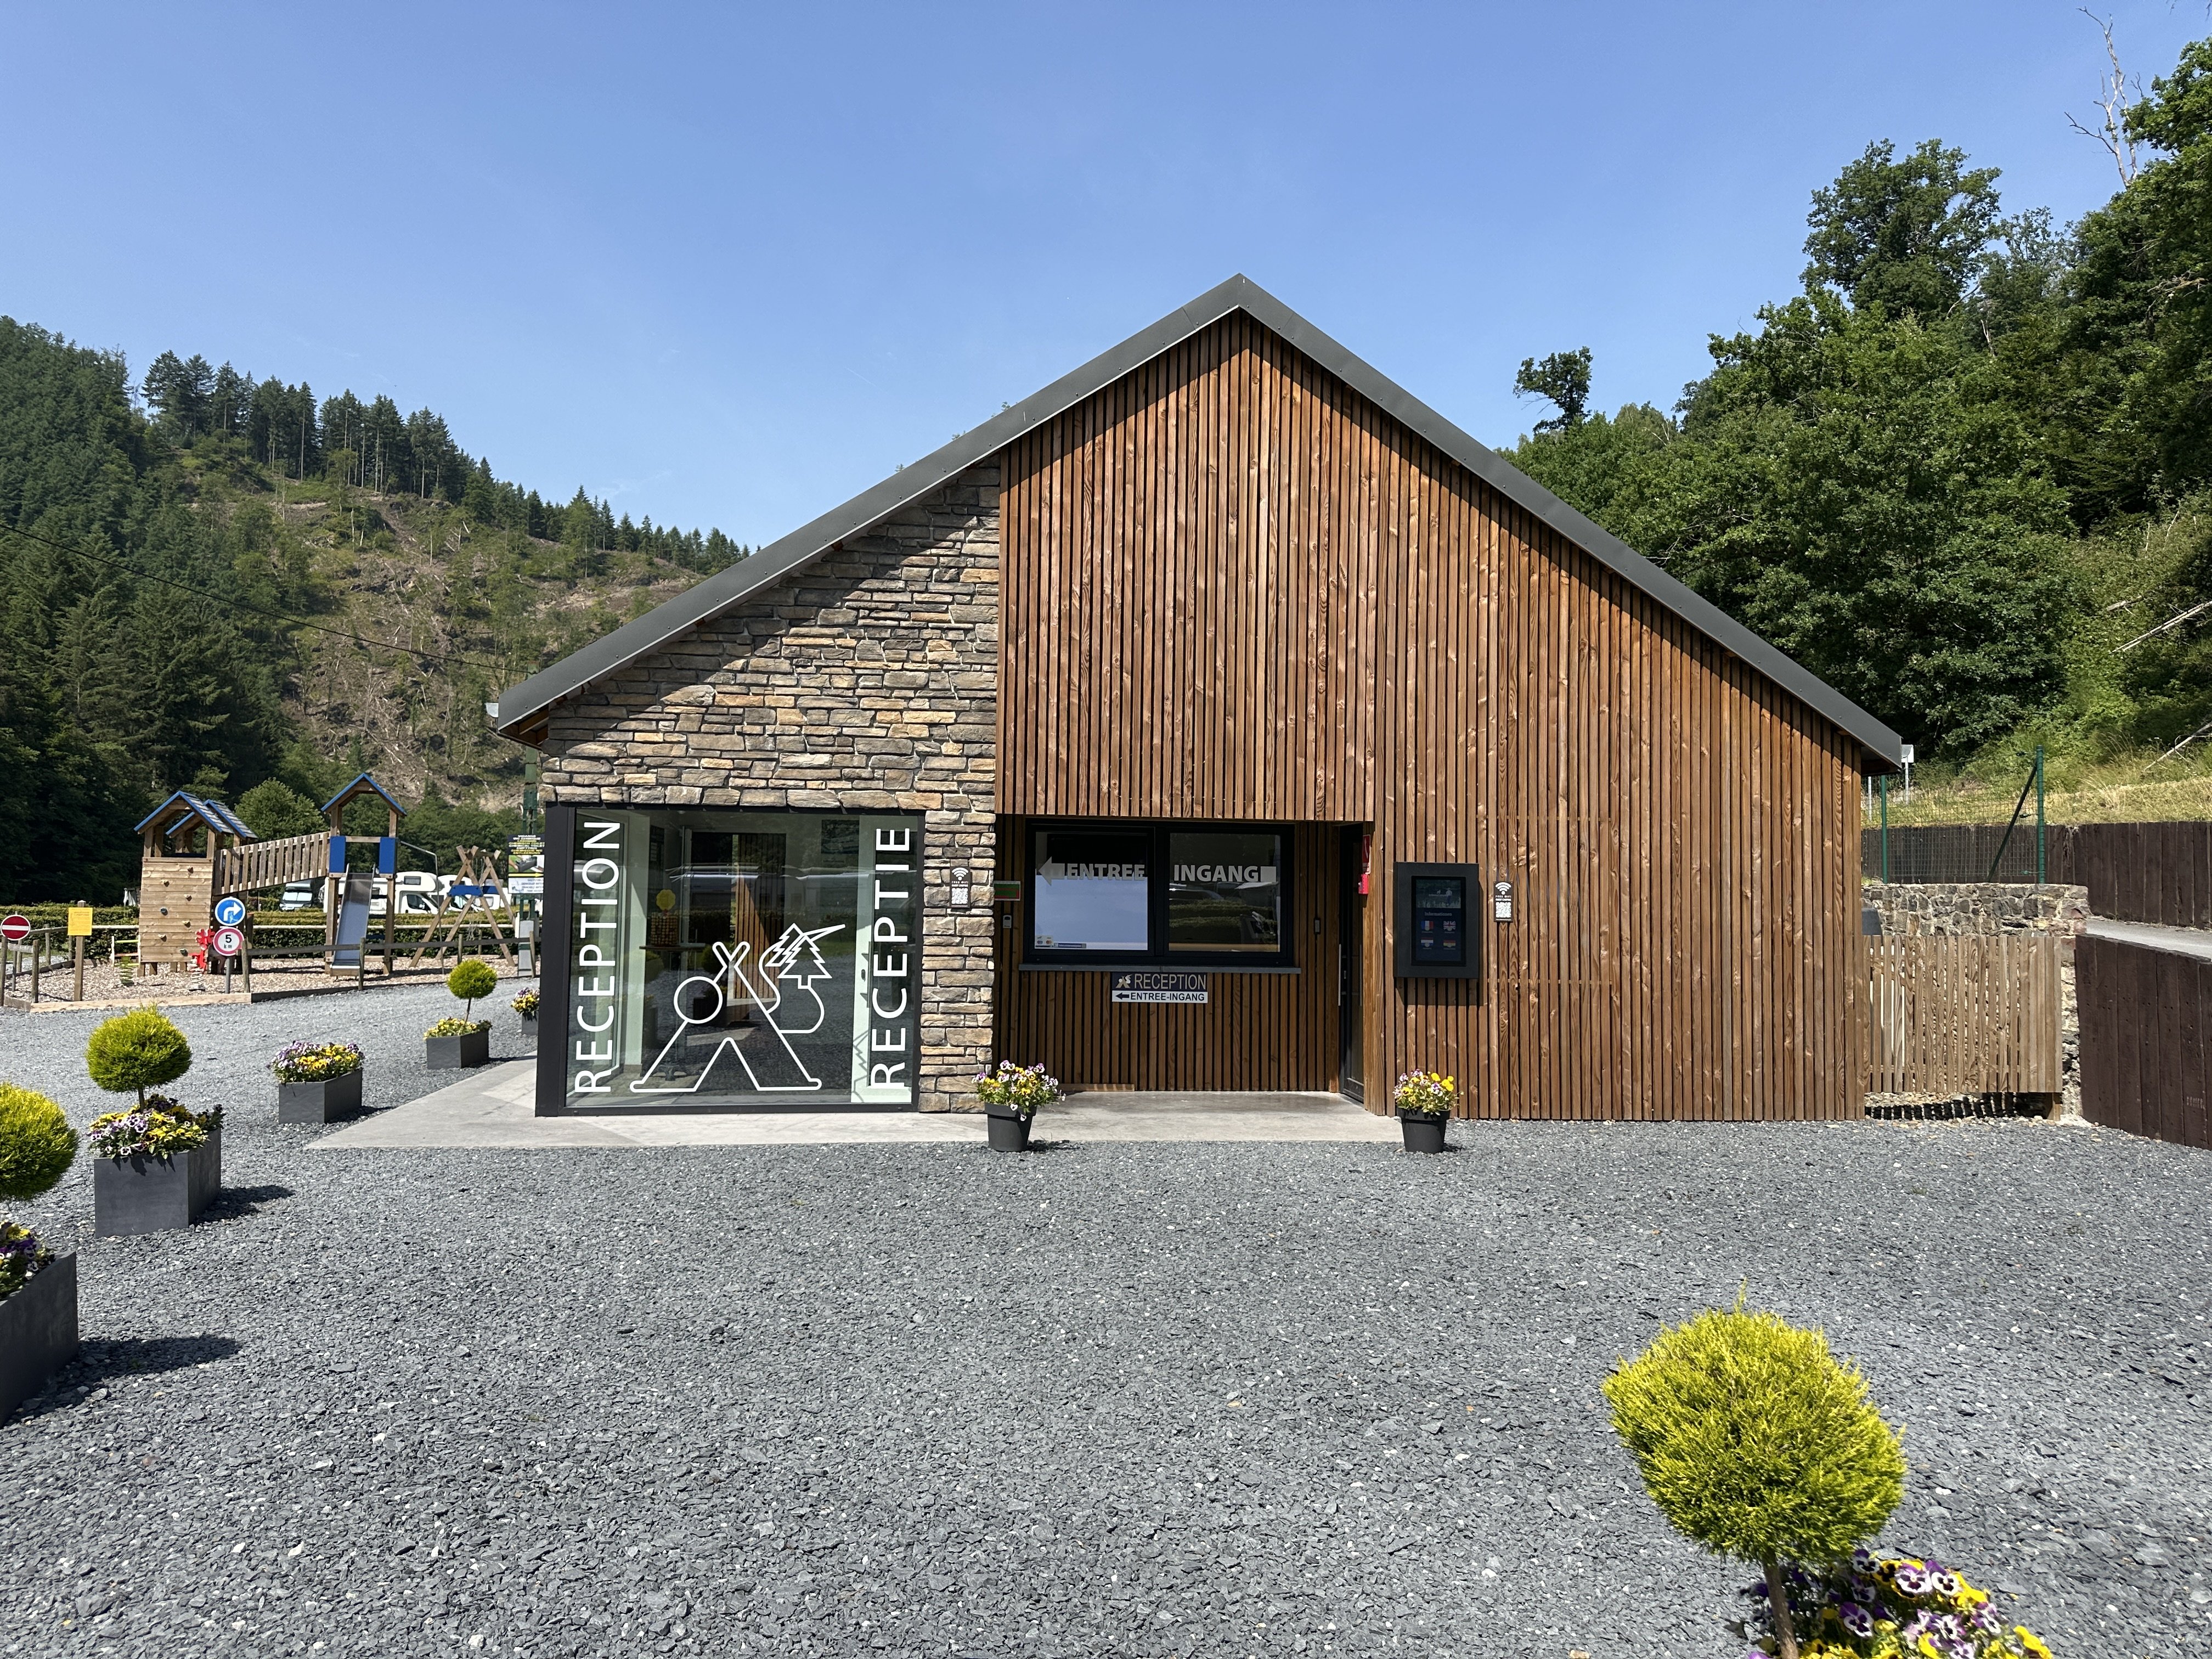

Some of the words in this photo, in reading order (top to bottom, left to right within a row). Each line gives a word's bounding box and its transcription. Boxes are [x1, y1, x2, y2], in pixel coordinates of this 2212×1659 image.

[1067, 863, 1146, 881] ENTREE
[1174, 864, 1259, 882] INGANG
[225, 934, 232, 943] 5
[574, 822, 620, 1092] RECEPTION
[870, 828, 910, 1089] RECEPTIE
[1134, 973, 1206, 990] RECEPTION
[1130, 992, 1205, 1001] ENTREE-INGANG
